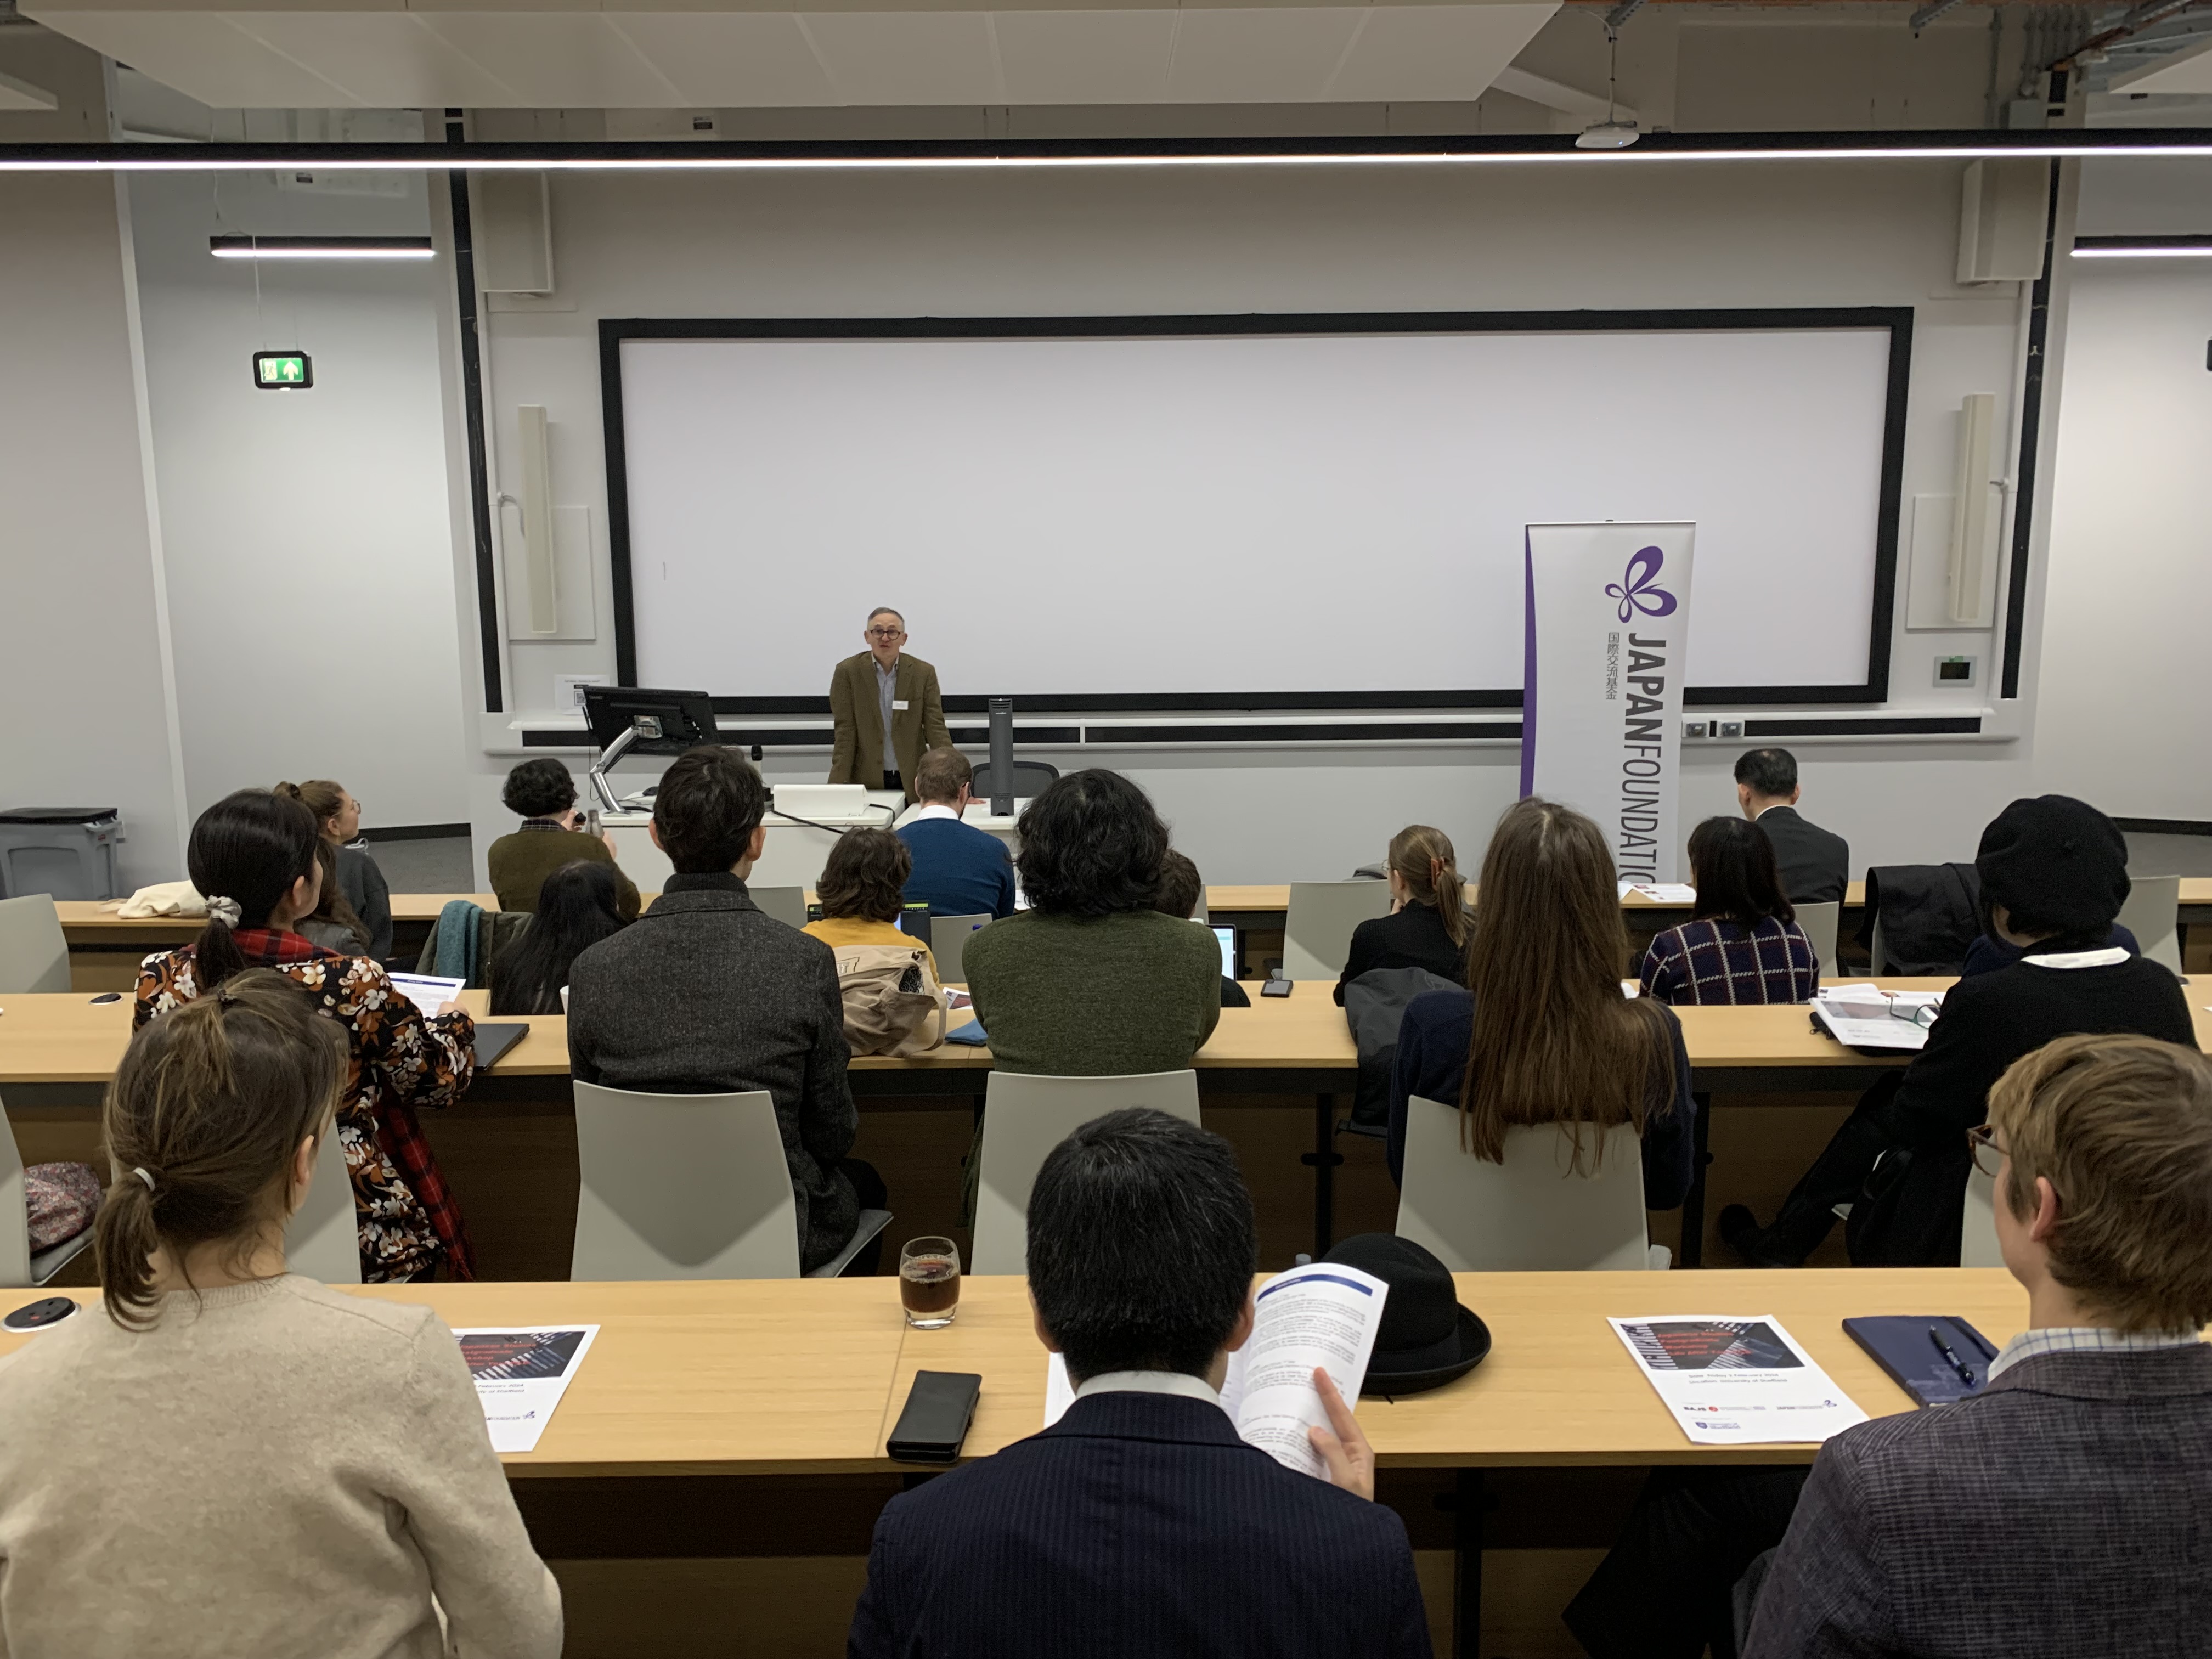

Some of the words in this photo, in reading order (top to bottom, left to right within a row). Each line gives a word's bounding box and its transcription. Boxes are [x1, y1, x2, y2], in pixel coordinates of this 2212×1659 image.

[1606, 631, 1620, 700] 国際交流基金
[1618, 633, 1666, 883] JAPANFOUNDATIO
